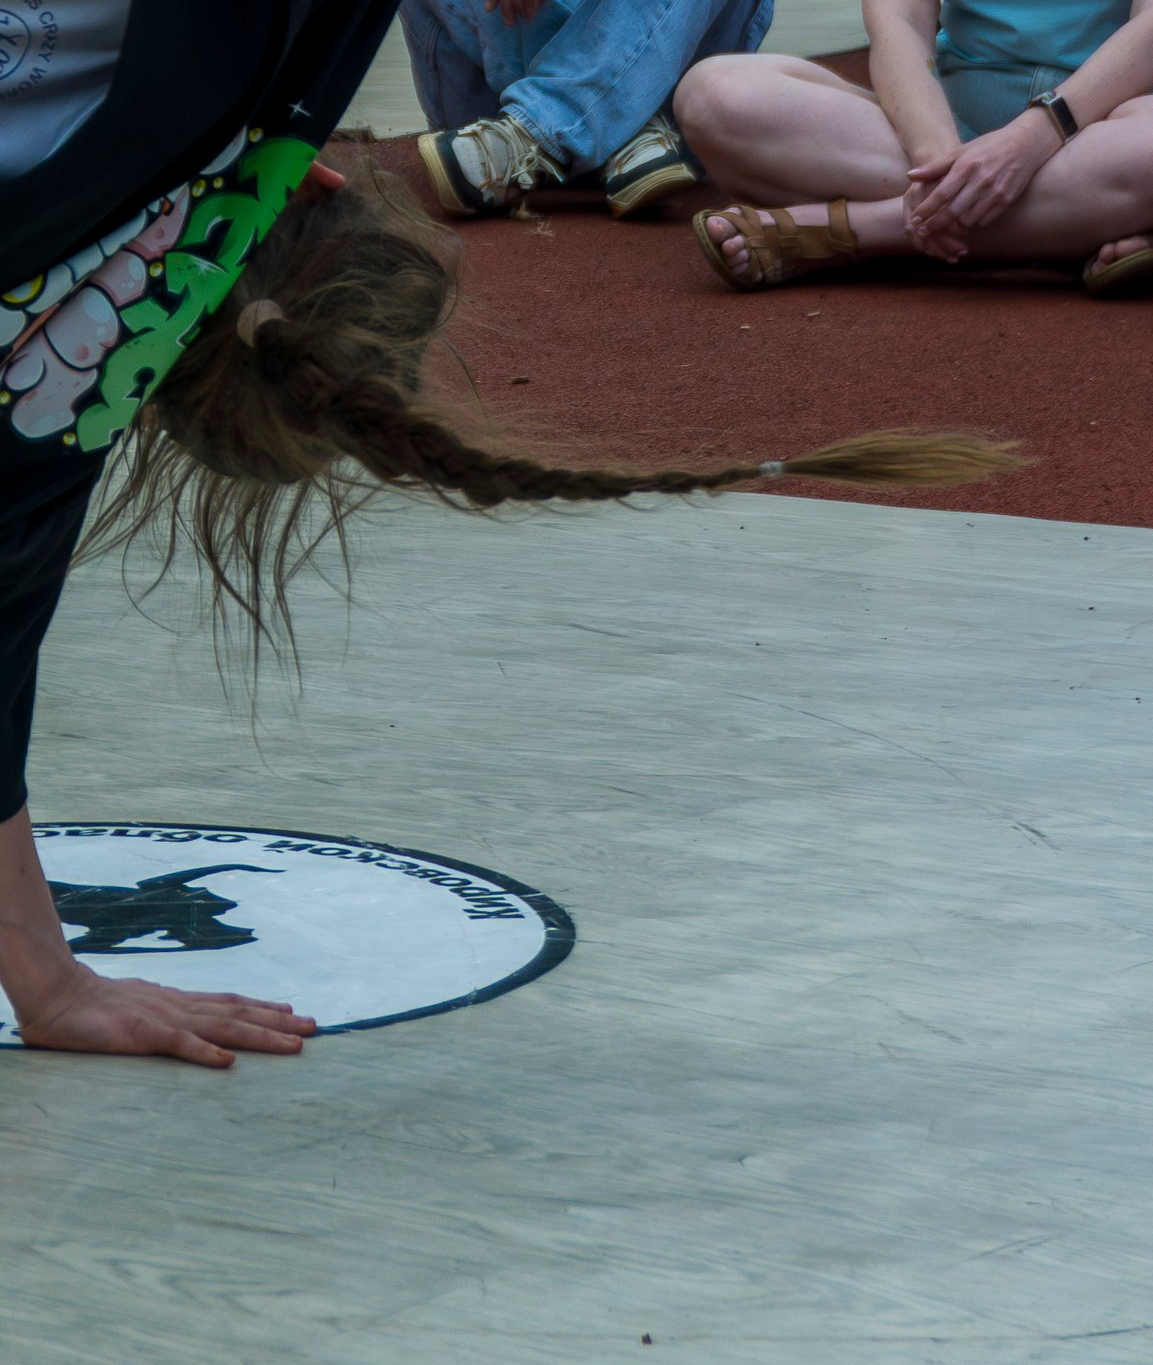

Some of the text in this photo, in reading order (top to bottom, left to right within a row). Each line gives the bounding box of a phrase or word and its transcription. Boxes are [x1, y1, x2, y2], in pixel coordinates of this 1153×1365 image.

[39, 11, 59, 63] CRAZY
[32, 826, 525, 920] Кировской облас
